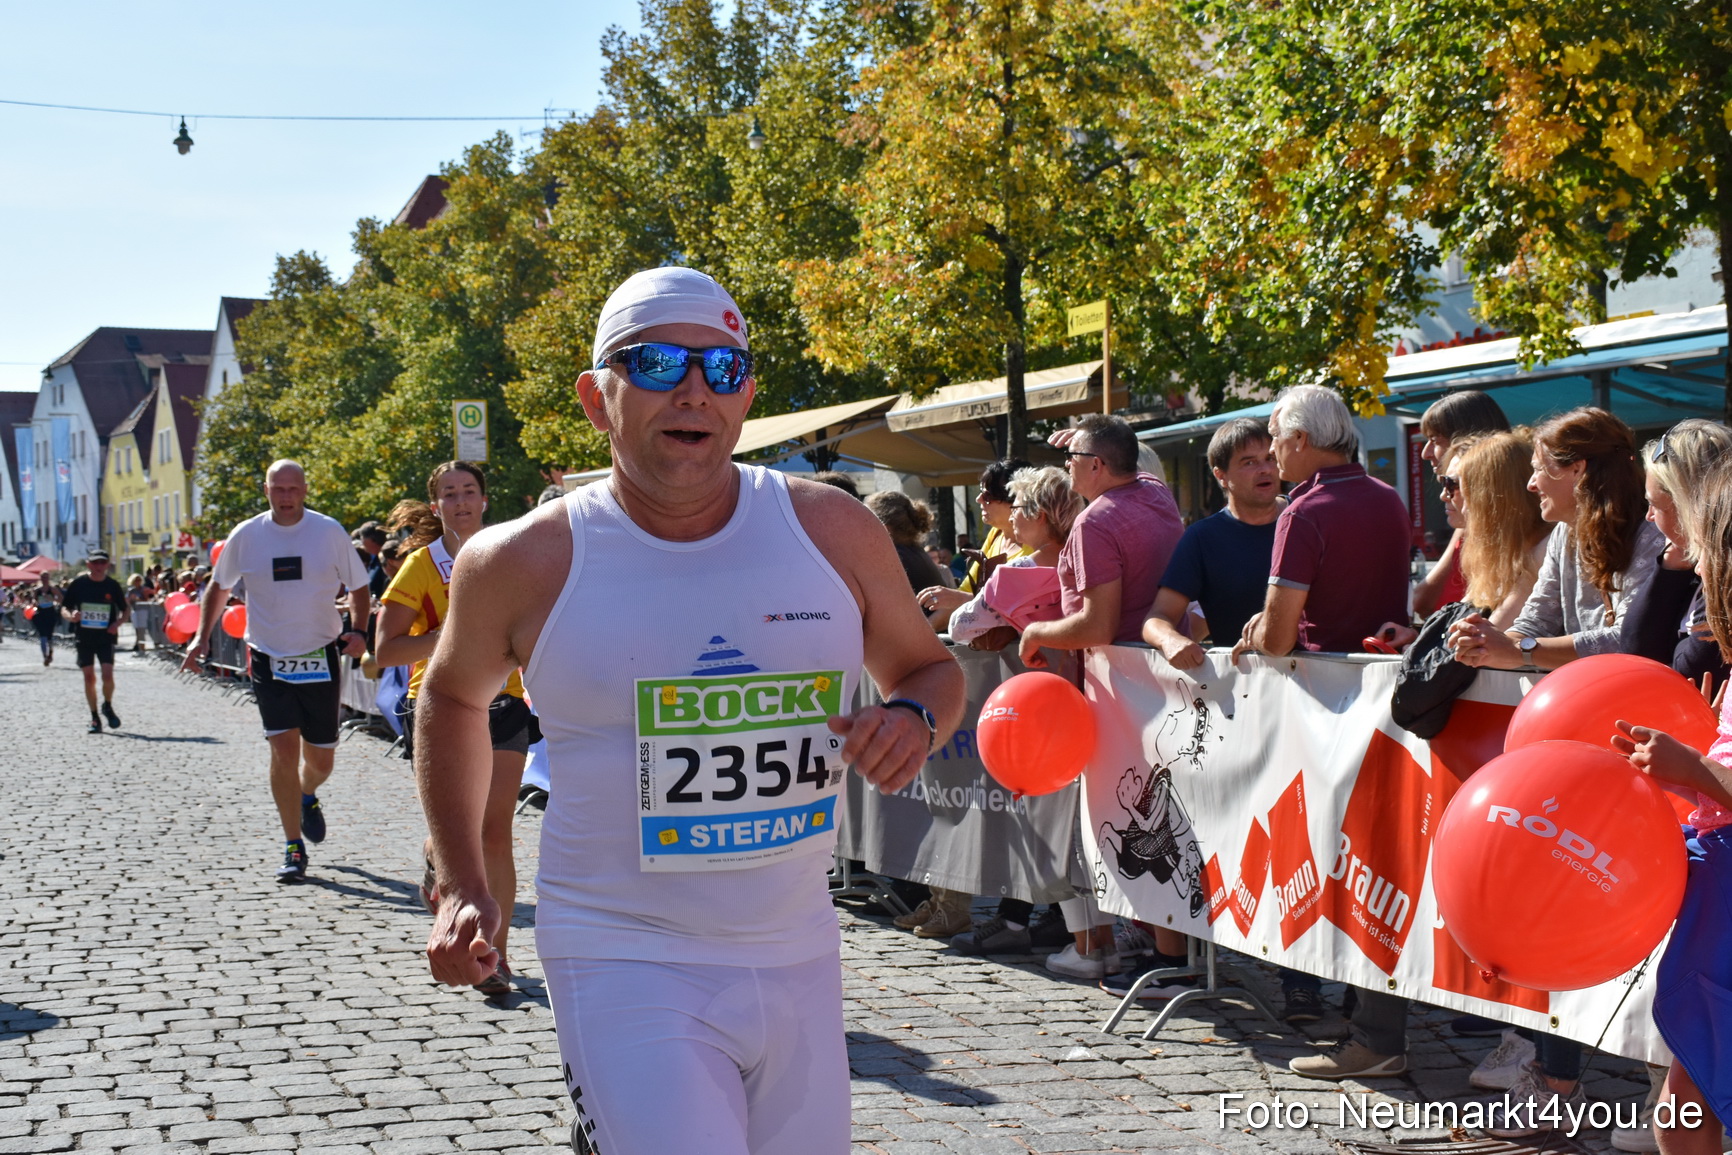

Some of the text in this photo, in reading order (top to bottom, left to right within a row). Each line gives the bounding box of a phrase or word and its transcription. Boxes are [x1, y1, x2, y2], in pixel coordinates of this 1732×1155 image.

[1075, 312, 1104, 326] Toiletten
[785, 611, 831, 621] BIONIC
[276, 660, 320, 673] 2717
[654, 680, 827, 729] BOCK
[666, 737, 829, 803] 2354
[1425, 792, 1433, 816] 1929
[690, 812, 808, 848] STEFAN
[1325, 831, 1411, 934] Braun
[1551, 849, 1612, 893] energie
[1274, 859, 1317, 922] Braun
[1352, 904, 1369, 929] Sicher
[1368, 922, 1380, 938] ist
